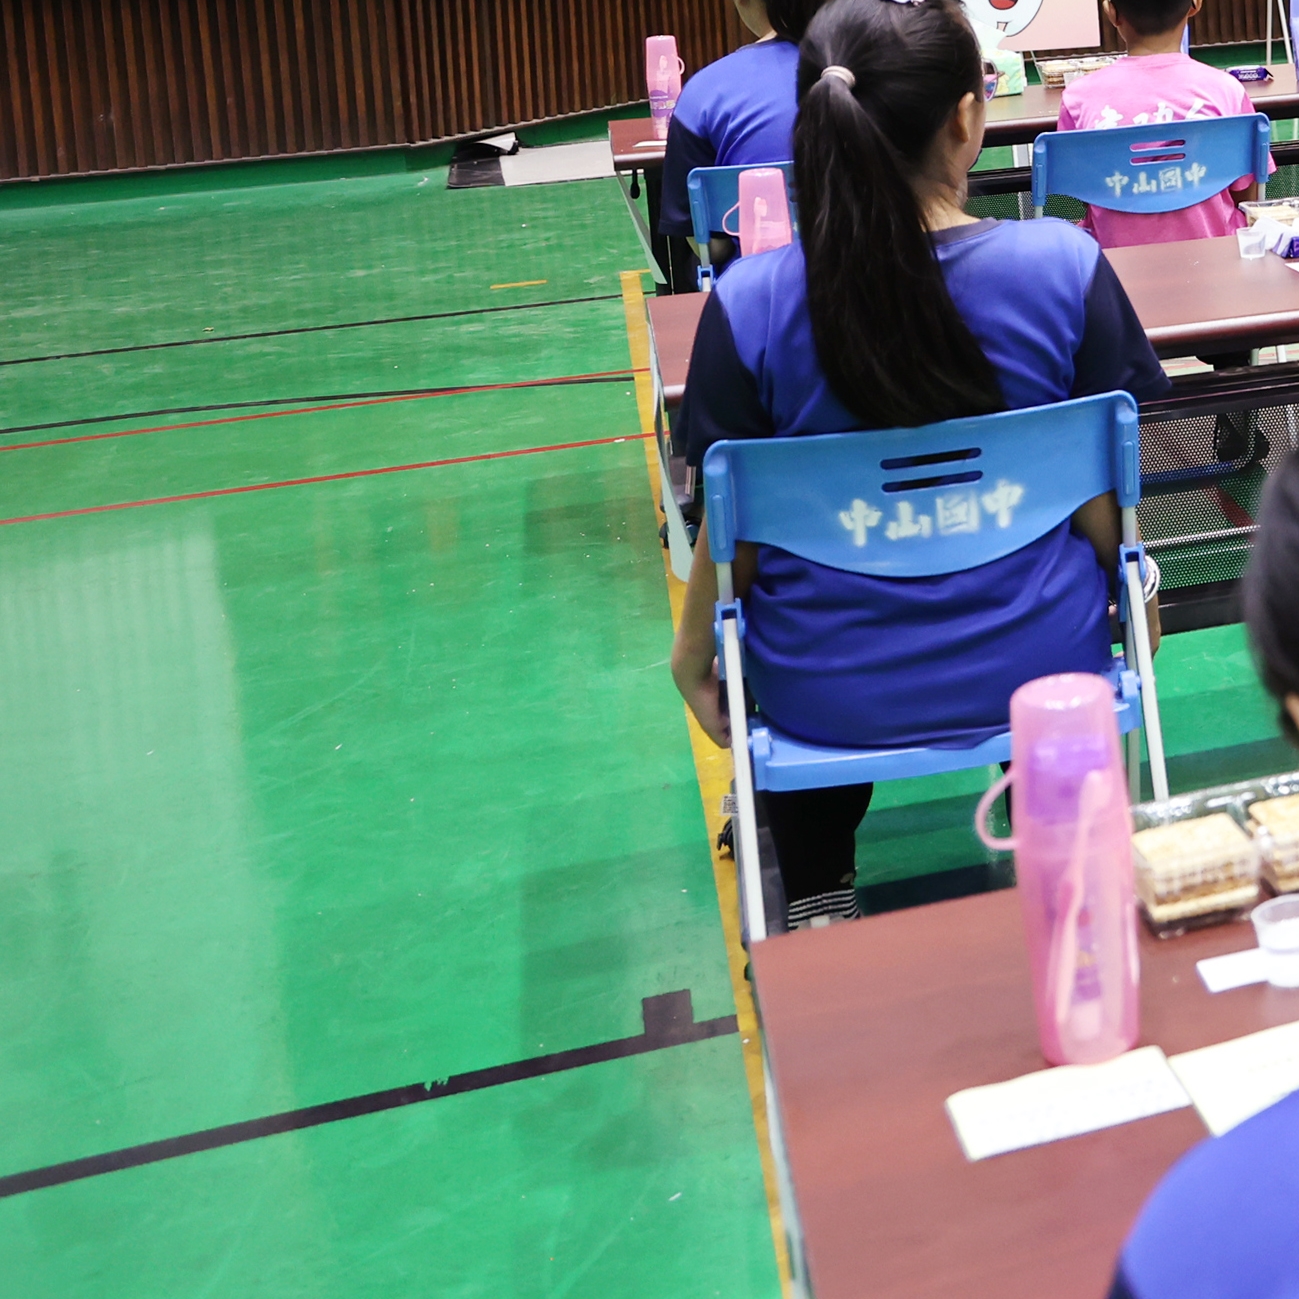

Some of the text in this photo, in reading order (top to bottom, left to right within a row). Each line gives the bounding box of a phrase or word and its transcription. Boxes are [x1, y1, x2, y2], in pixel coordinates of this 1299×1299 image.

[1105, 162, 1207, 198] 中山國中
[838, 479, 1024, 547] 中山國中
